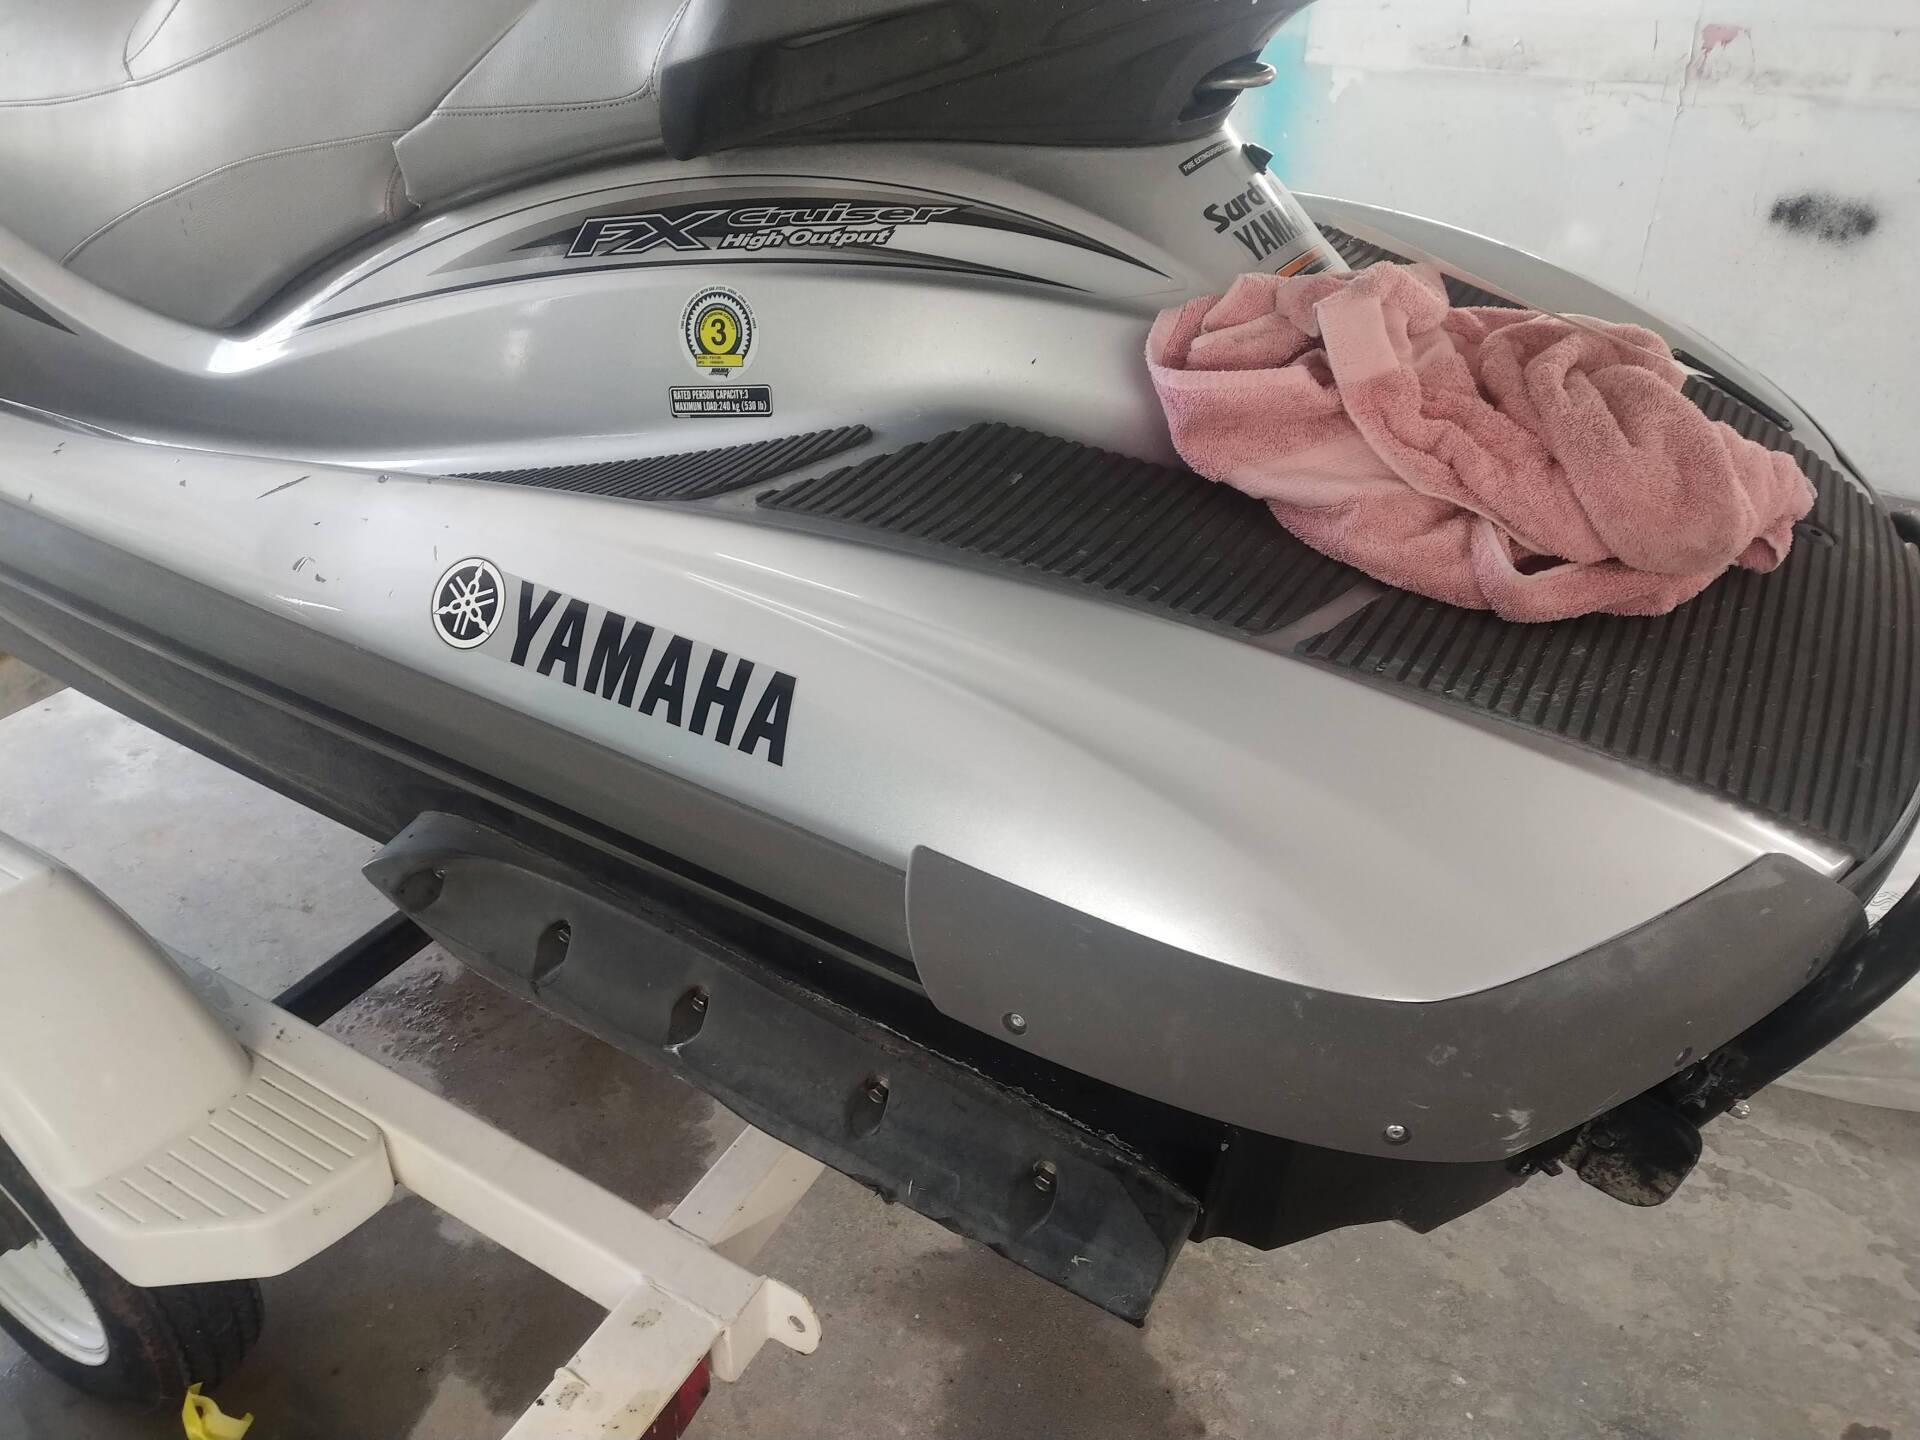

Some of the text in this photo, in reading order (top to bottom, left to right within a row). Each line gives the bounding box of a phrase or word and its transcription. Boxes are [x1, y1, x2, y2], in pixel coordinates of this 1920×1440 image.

[565, 203, 960, 258] FX Cruiser
[719, 225, 894, 249] High Output
[711, 318, 726, 345] 3
[673, 389, 749, 400] RATED PERSON CAPACITY:3
[674, 400, 767, 412] MAXIMUM LOAD:240 kg (530 lb)
[510, 580, 797, 767] YAMAHA
